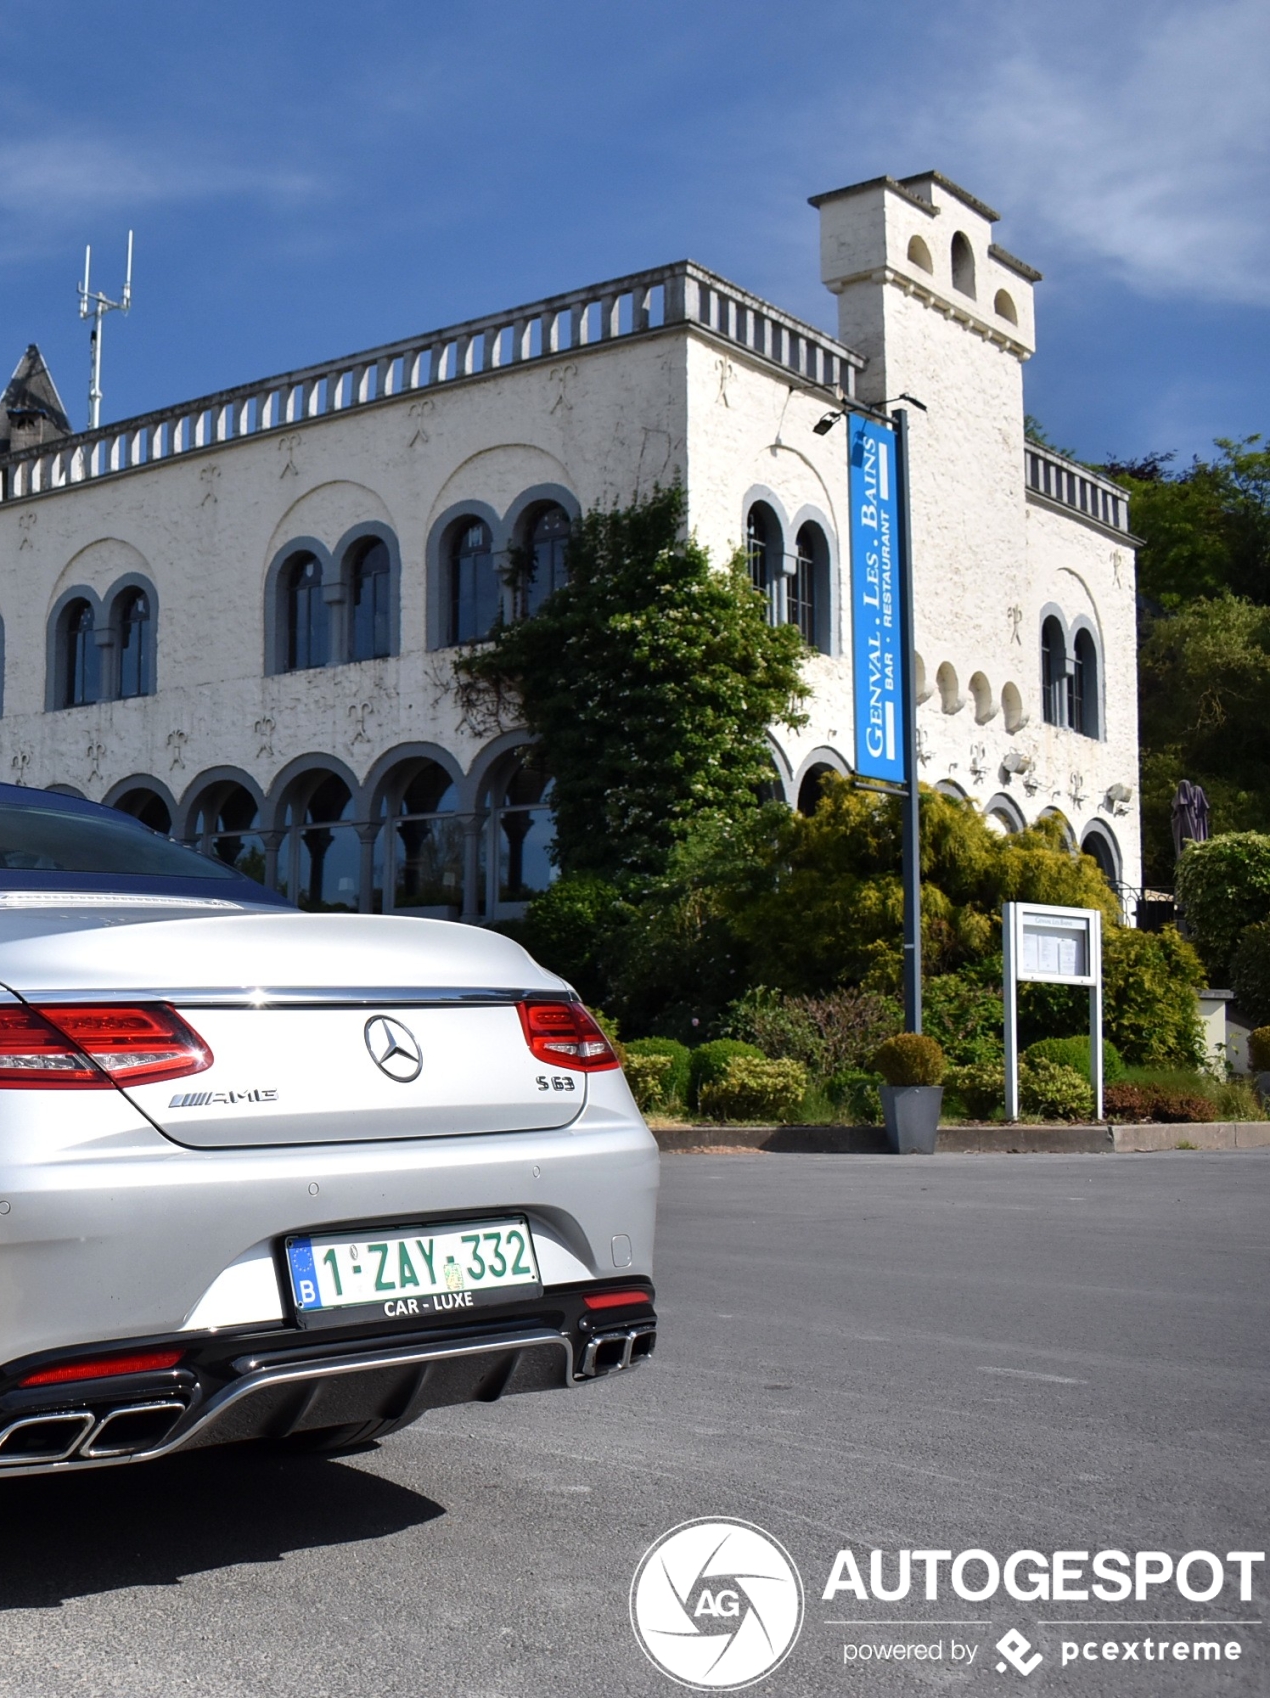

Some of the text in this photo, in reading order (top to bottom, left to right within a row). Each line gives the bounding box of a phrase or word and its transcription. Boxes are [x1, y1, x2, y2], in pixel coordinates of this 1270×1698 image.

[861, 435, 878, 531] BAINS
[863, 551, 880, 610] LES
[880, 508, 893, 628] RESTAURANT
[866, 631, 884, 758] GENVAL
[884, 653, 894, 691] BAR
[205, 1088, 279, 1105] AMG
[384, 1299, 420, 1318] CAR
[433, 1291, 474, 1312] LUXE
